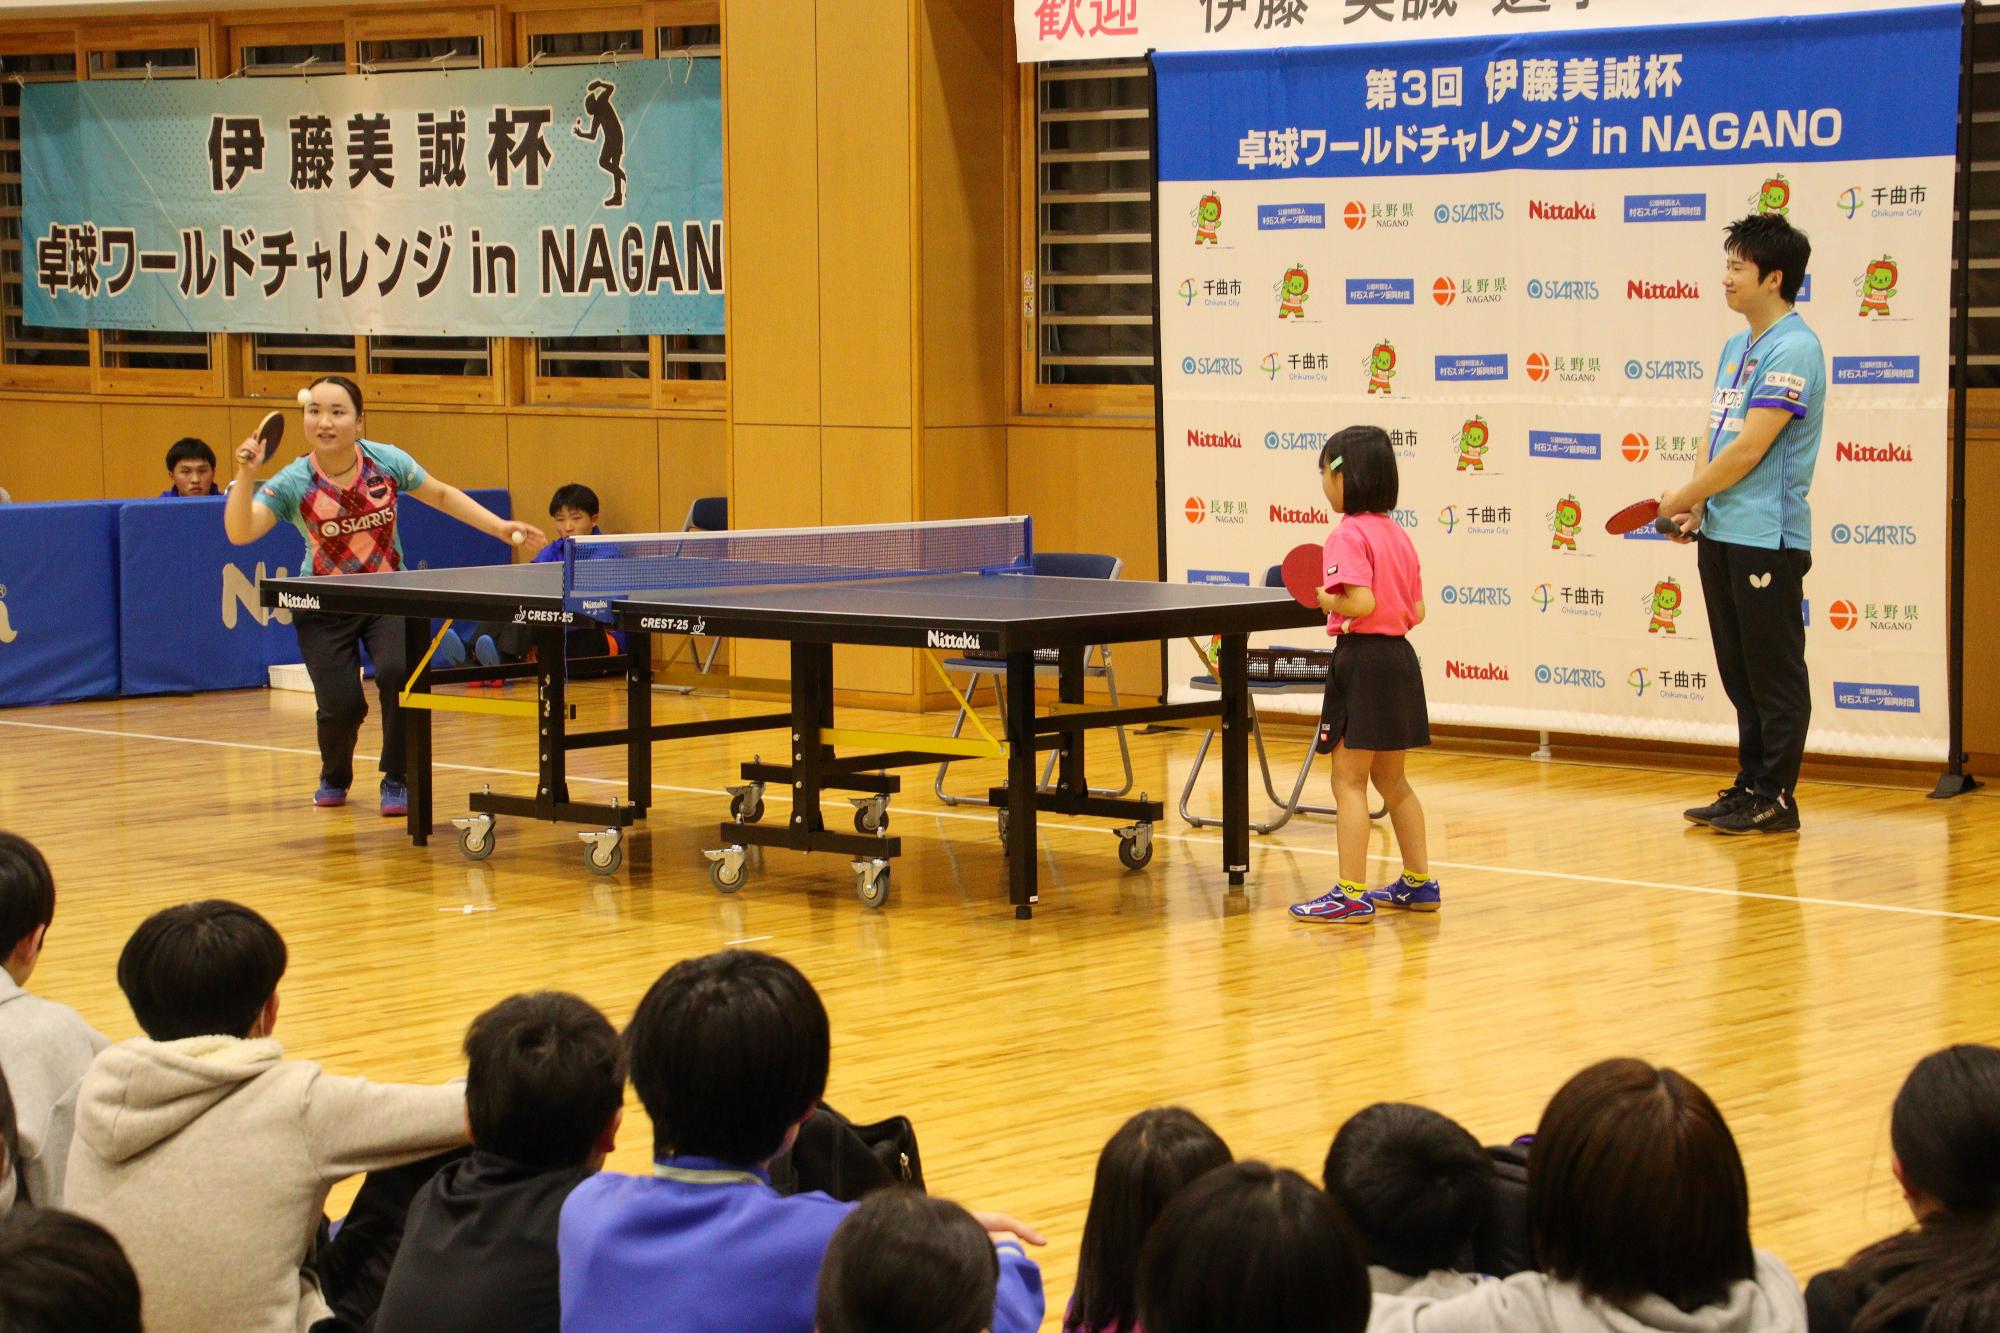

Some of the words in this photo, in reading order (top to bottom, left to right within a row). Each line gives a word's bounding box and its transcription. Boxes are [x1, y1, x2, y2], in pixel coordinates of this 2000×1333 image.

[1034, 0, 1139, 41] 歓迎
[1364, 65, 1463, 110] 第3回
[1484, 53, 1683, 104] 伊藤美誠杯
[1237, 115, 1580, 170] 卓球ワールドチャレンジ
[1592, 118, 1627, 155] in
[1641, 107, 1843, 153] NAGANO
[207, 107, 554, 192] 伊藤美誠杯
[1871, 184, 1928, 206] 千曲市
[1371, 202, 1415, 218] 長野県
[1451, 201, 1505, 223] STARTS
[1527, 198, 1596, 221] Nittaku
[1871, 208, 1904, 218] Chikuma
[1906, 208, 1923, 218] City
[1376, 219, 1409, 228] NAGANO
[36, 222, 453, 298] 卓球ワールドチャレンジ
[472, 230, 516, 295] in
[1203, 278, 1242, 297] 千曲市
[1461, 276, 1507, 294] 長野県
[1543, 280, 1600, 300] STARTS
[1626, 279, 1700, 300] Nittaku
[1466, 294, 1502, 304] NAGANO
[1198, 357, 1243, 376] STARTS
[1287, 352, 1329, 371] 千曲市
[1553, 356, 1600, 372] 長野県
[1645, 360, 1704, 380] STARTS
[1559, 373, 1595, 382] NAGANO
[1187, 429, 1242, 449] Nittaku
[1390, 429, 1418, 447] 曲市
[1836, 441, 1914, 463] Nittaku
[1209, 499, 1249, 515] 長野県
[1269, 504, 1329, 526] Nittaku
[1466, 505, 1512, 524] 千曲市
[340, 508, 394, 534] STARTS
[1215, 515, 1244, 525] NAGANO
[1853, 525, 1917, 546] STARTS
[278, 591, 320, 610] Nittaku
[1458, 585, 1512, 606] STARTS
[1560, 586, 1604, 606] 千曲市
[1863, 603, 1920, 622] 長野県
[640, 617, 689, 630] CREST-25
[1870, 621, 1913, 632] NAGANO
[926, 628, 981, 651] Nittaku
[1445, 659, 1510, 681] Nittaku
[1553, 668, 1606, 689] STARTS
[1658, 669, 1707, 689] 千曲市
[1690, 691, 1705, 702] City
